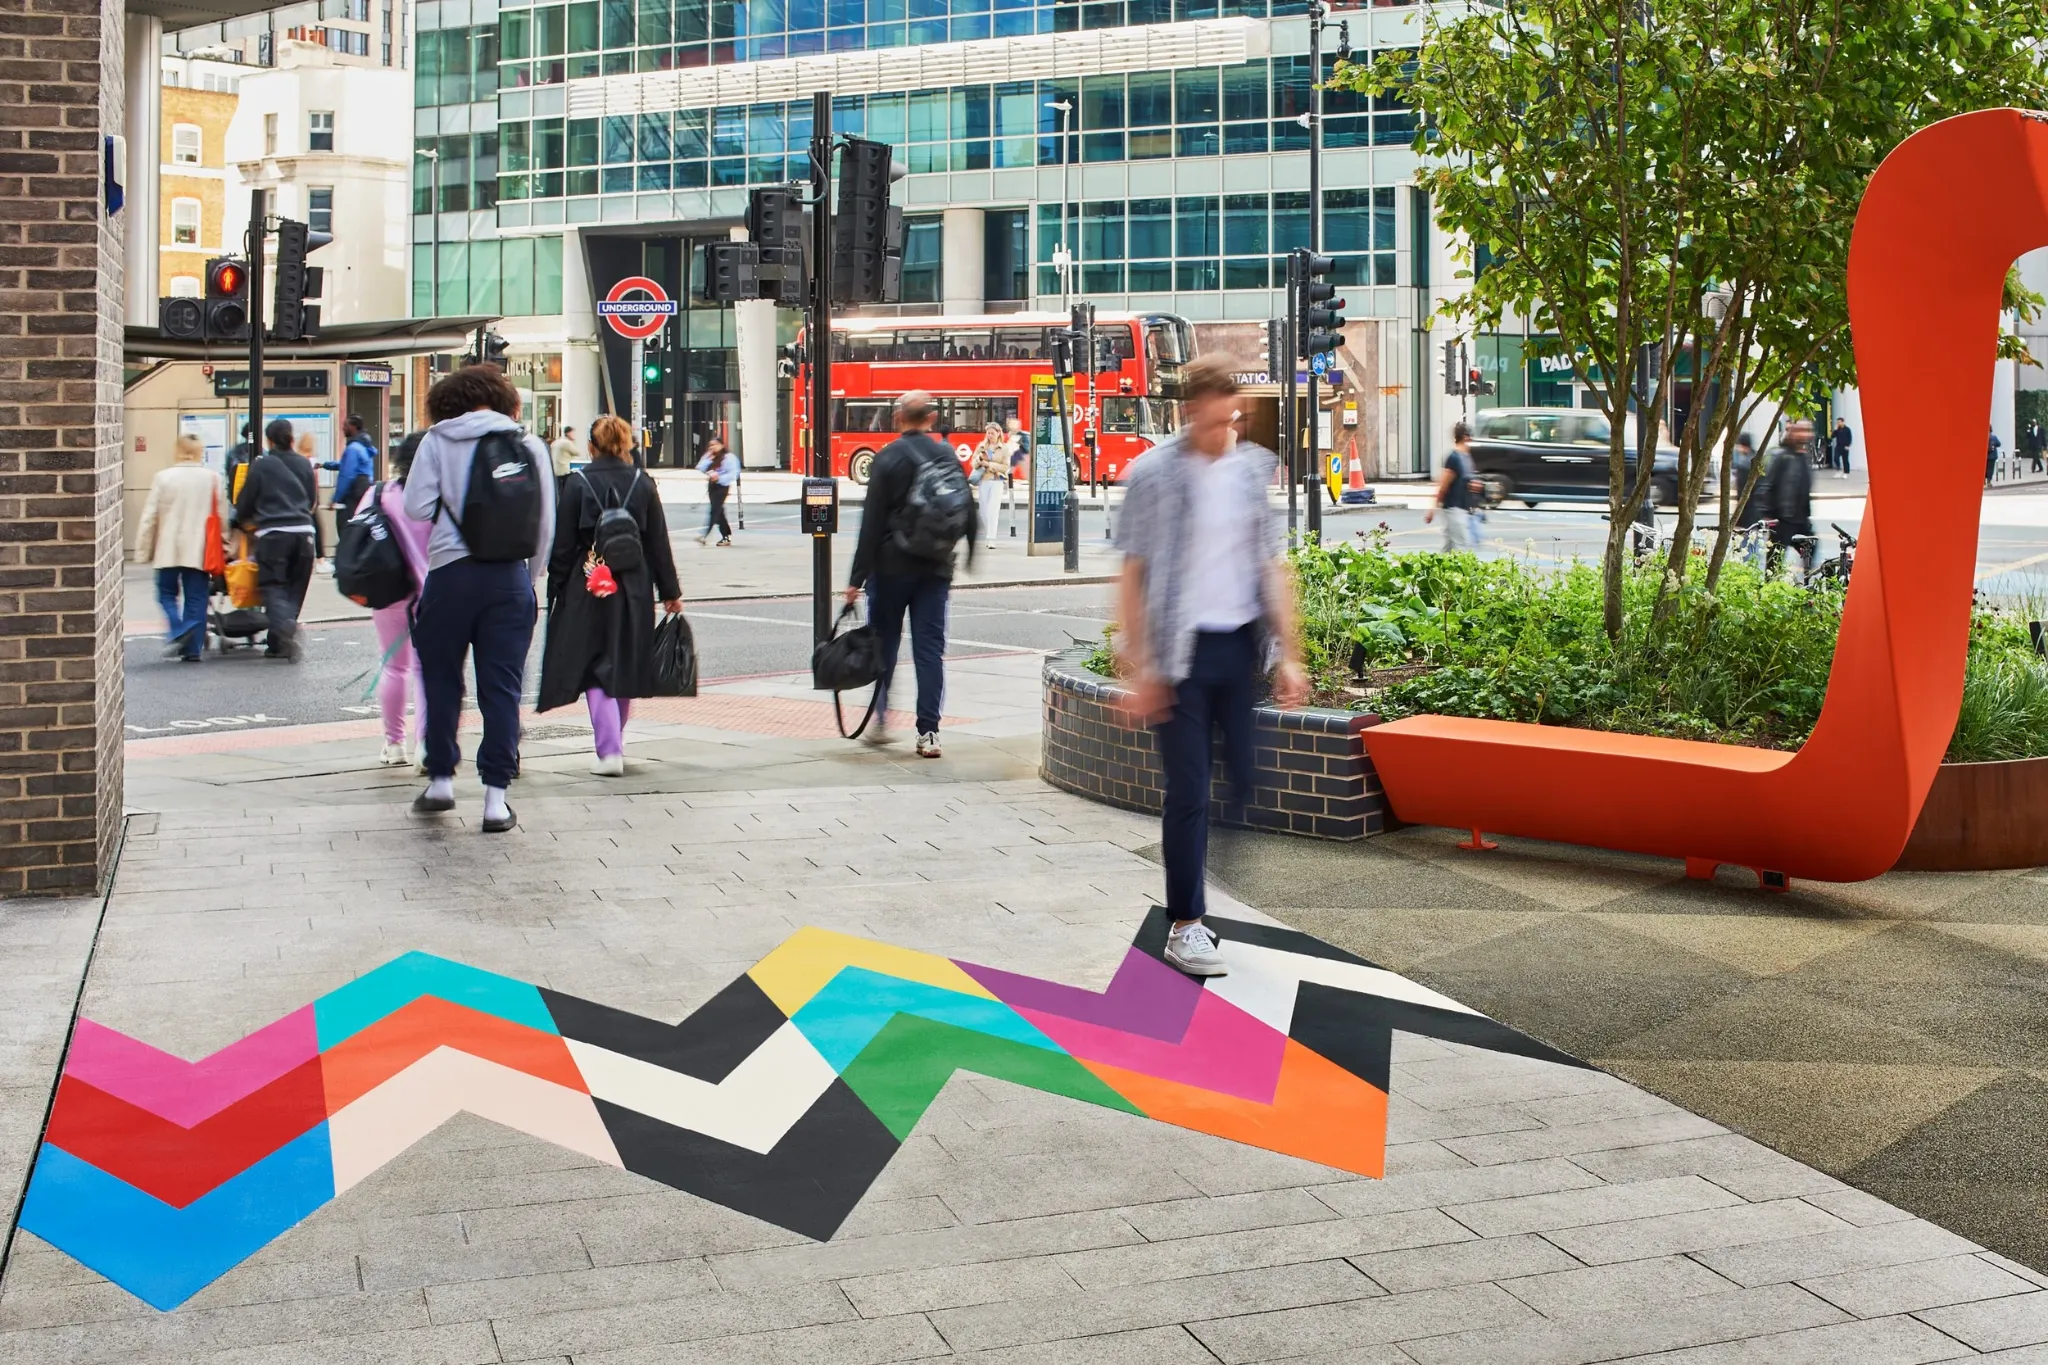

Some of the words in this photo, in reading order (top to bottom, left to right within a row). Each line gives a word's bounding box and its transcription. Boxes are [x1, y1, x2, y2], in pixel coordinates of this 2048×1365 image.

[602, 303, 671, 312] UNDERGROUND
[738, 326, 748, 398] BUILDING
[1229, 373, 1277, 384] STATIO
[124, 713, 287, 732] LOOK
